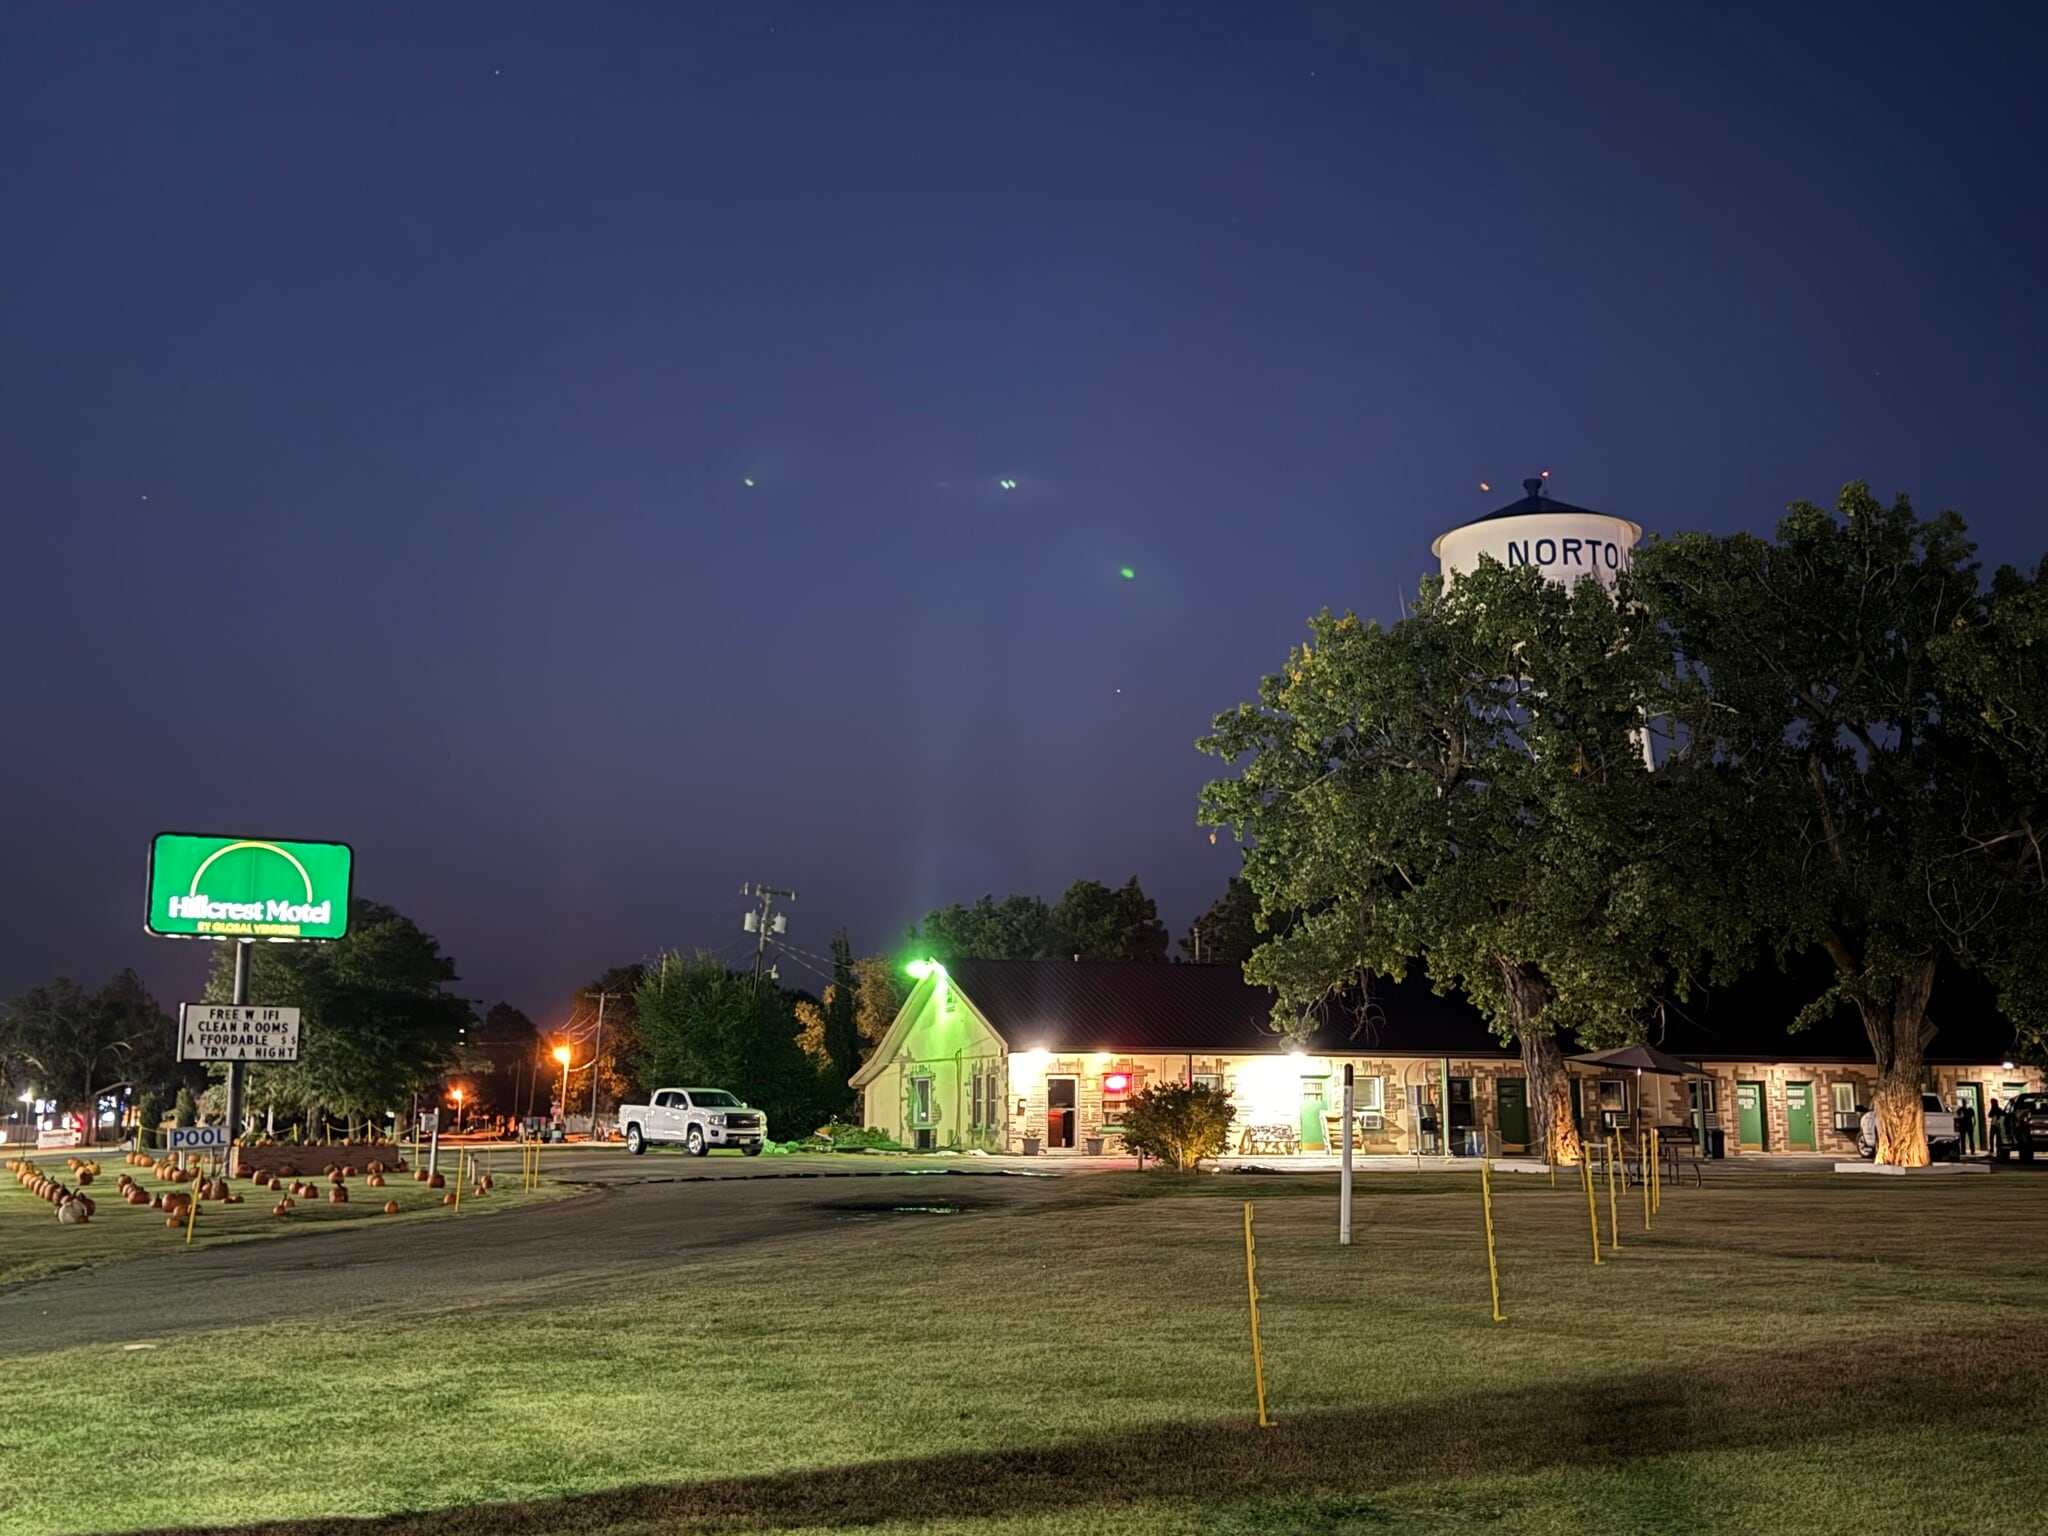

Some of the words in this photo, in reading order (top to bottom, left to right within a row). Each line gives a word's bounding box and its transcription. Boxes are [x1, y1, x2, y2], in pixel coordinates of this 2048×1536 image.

[168, 895, 264, 921] Hillcrest
[266, 900, 330, 923] Motel
[210, 1009, 239, 1020] FREE
[198, 1021, 237, 1032] CLEAN
[203, 1046, 227, 1057] TRY
[238, 1047, 246, 1057] A
[255, 1047, 294, 1057] NIGHT
[173, 1129, 226, 1146] POOL
